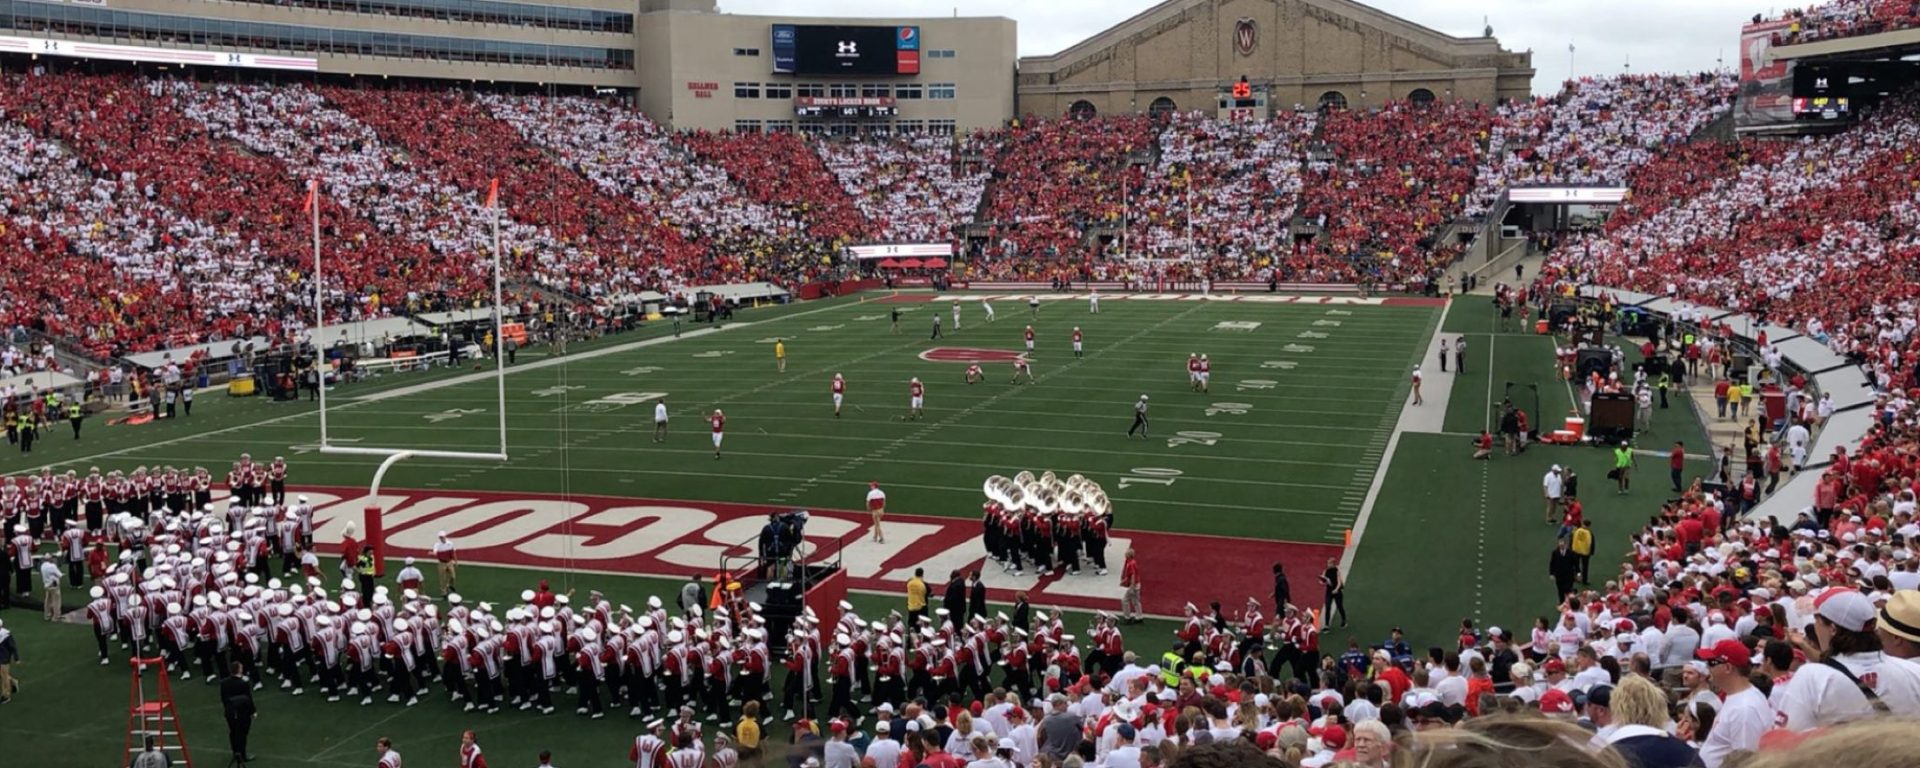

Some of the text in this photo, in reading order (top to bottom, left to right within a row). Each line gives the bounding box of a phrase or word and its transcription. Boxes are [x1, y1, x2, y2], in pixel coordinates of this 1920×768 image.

[1239, 28, 1254, 49] W
[1233, 82, 1251, 98] 25
[1167, 430, 1223, 447] 20
[1118, 467, 1183, 489] 10
[642, 739, 654, 751] W
[681, 754, 695, 767] W
